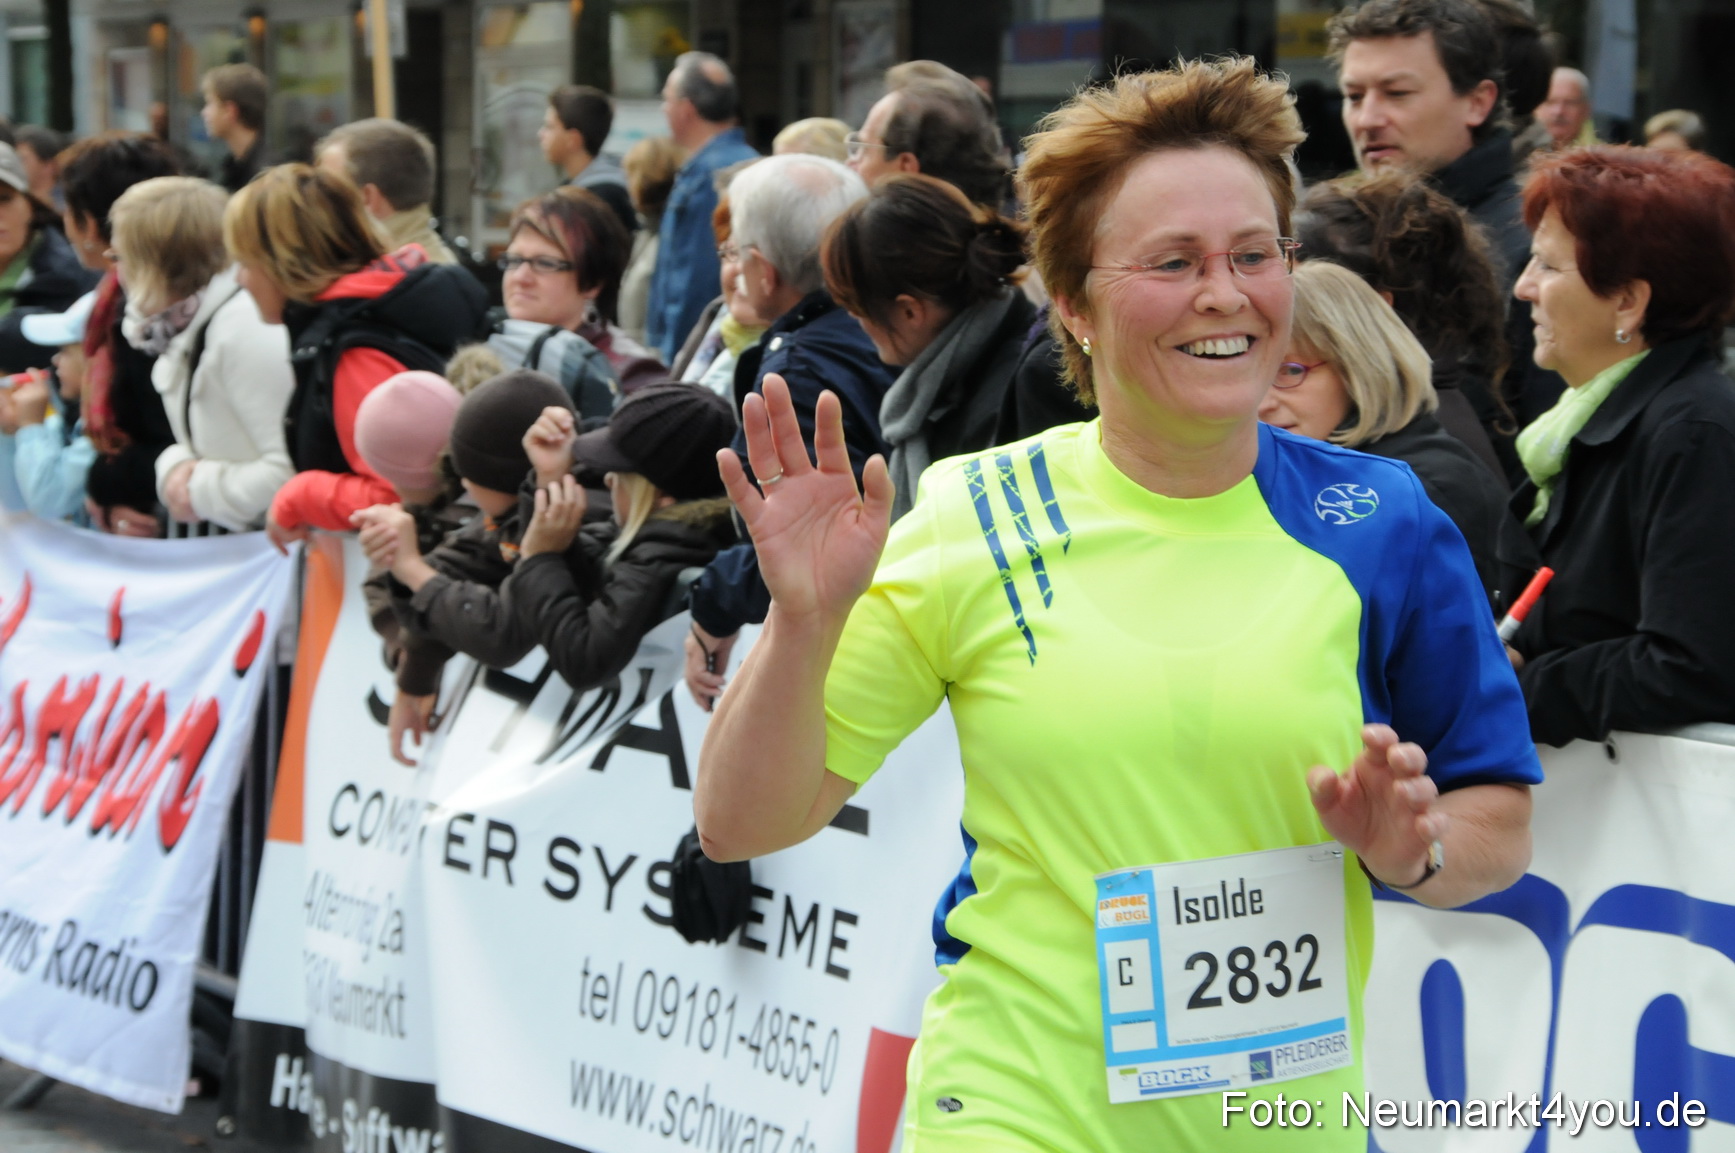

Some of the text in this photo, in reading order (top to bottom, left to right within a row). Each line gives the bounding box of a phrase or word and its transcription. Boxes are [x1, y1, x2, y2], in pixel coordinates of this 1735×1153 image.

[542, 836, 858, 980] SYSEME
[1173, 878, 1264, 925] Isolde
[43, 918, 158, 1012] Radio
[1118, 957, 1133, 986] C
[1184, 933, 1322, 1010] 2832
[579, 955, 839, 1096] tel 09181-4855-0
[1275, 1034, 1348, 1066] PFLEIDERER
[1139, 1066, 1211, 1087] BOCK
